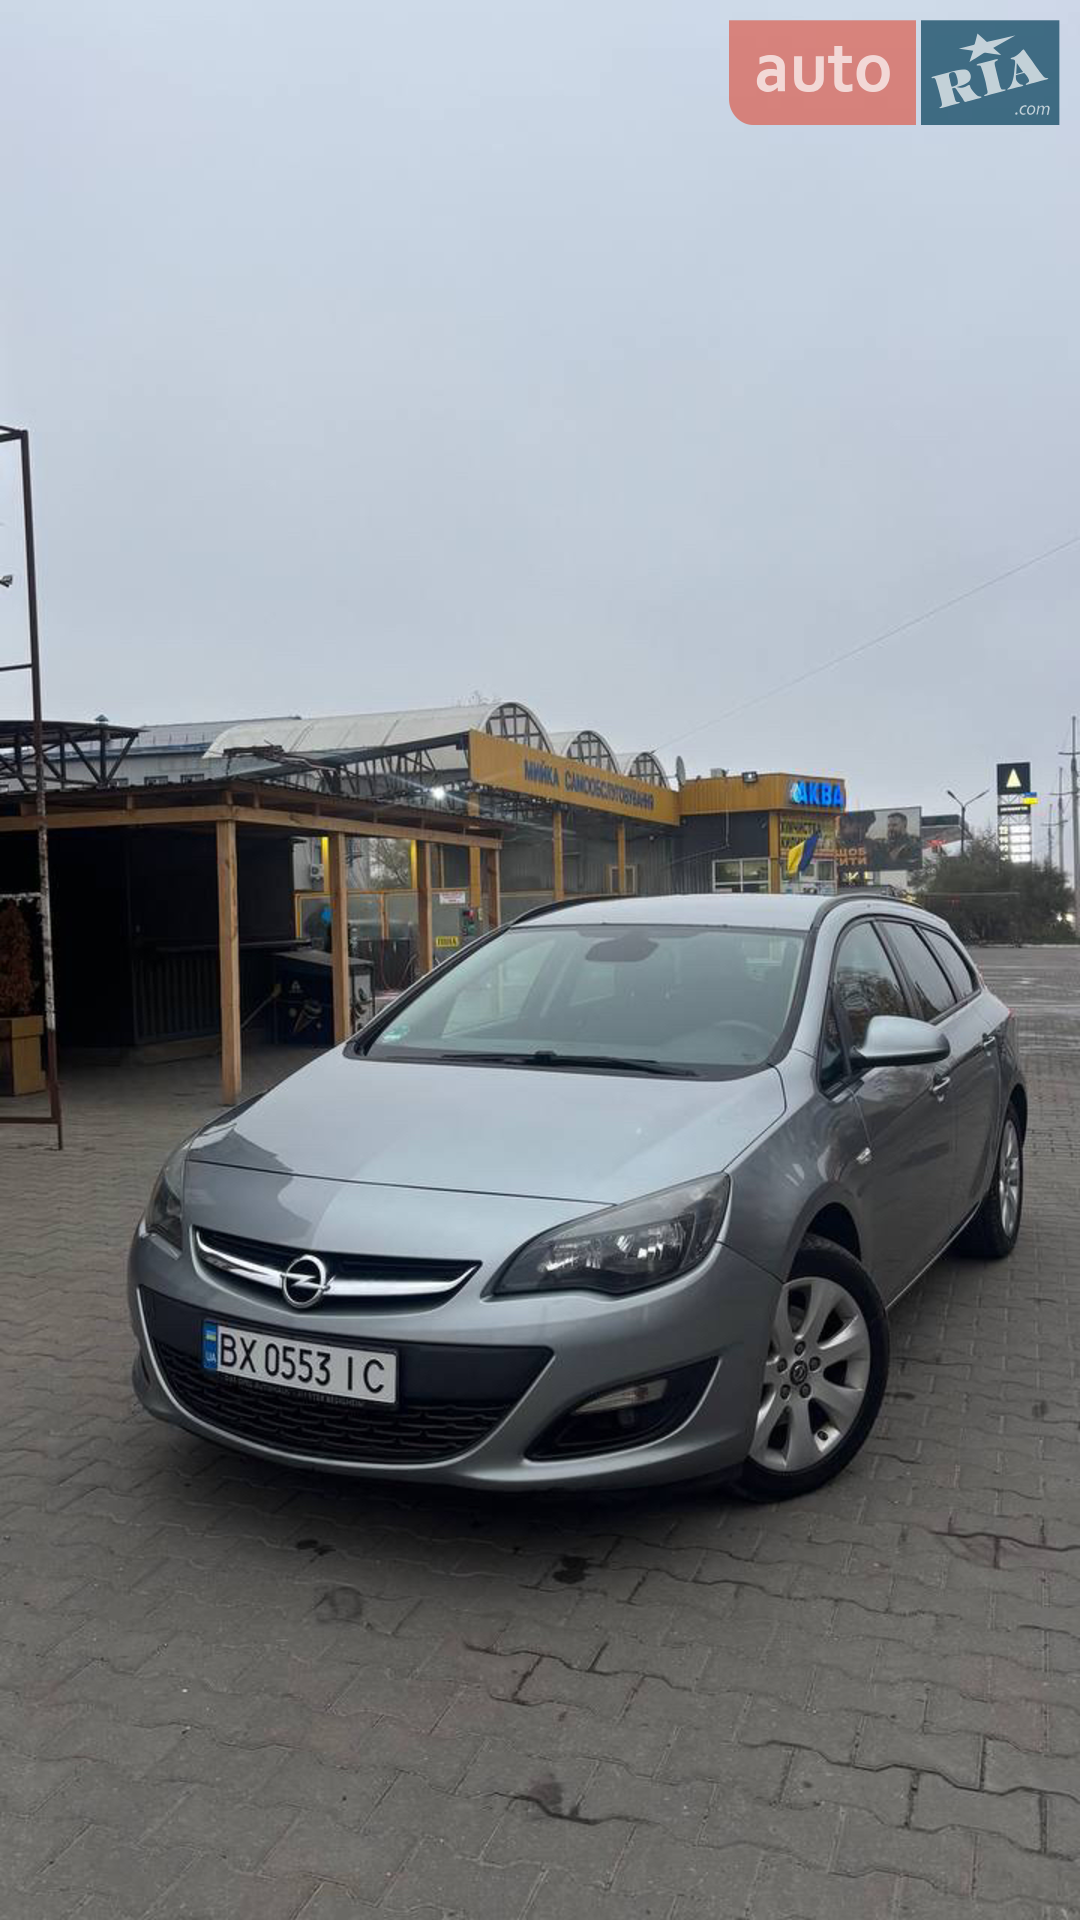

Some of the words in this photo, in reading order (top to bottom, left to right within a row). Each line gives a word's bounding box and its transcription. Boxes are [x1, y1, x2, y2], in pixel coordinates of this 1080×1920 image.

[524, 759, 560, 787] МИЙКА
[797, 780, 844, 808] АКВА
[205, 1352, 217, 1363] UA
[220, 1333, 257, 1373] BX
[264, 1343, 331, 1386] 0553
[347, 1355, 385, 1394] IC
